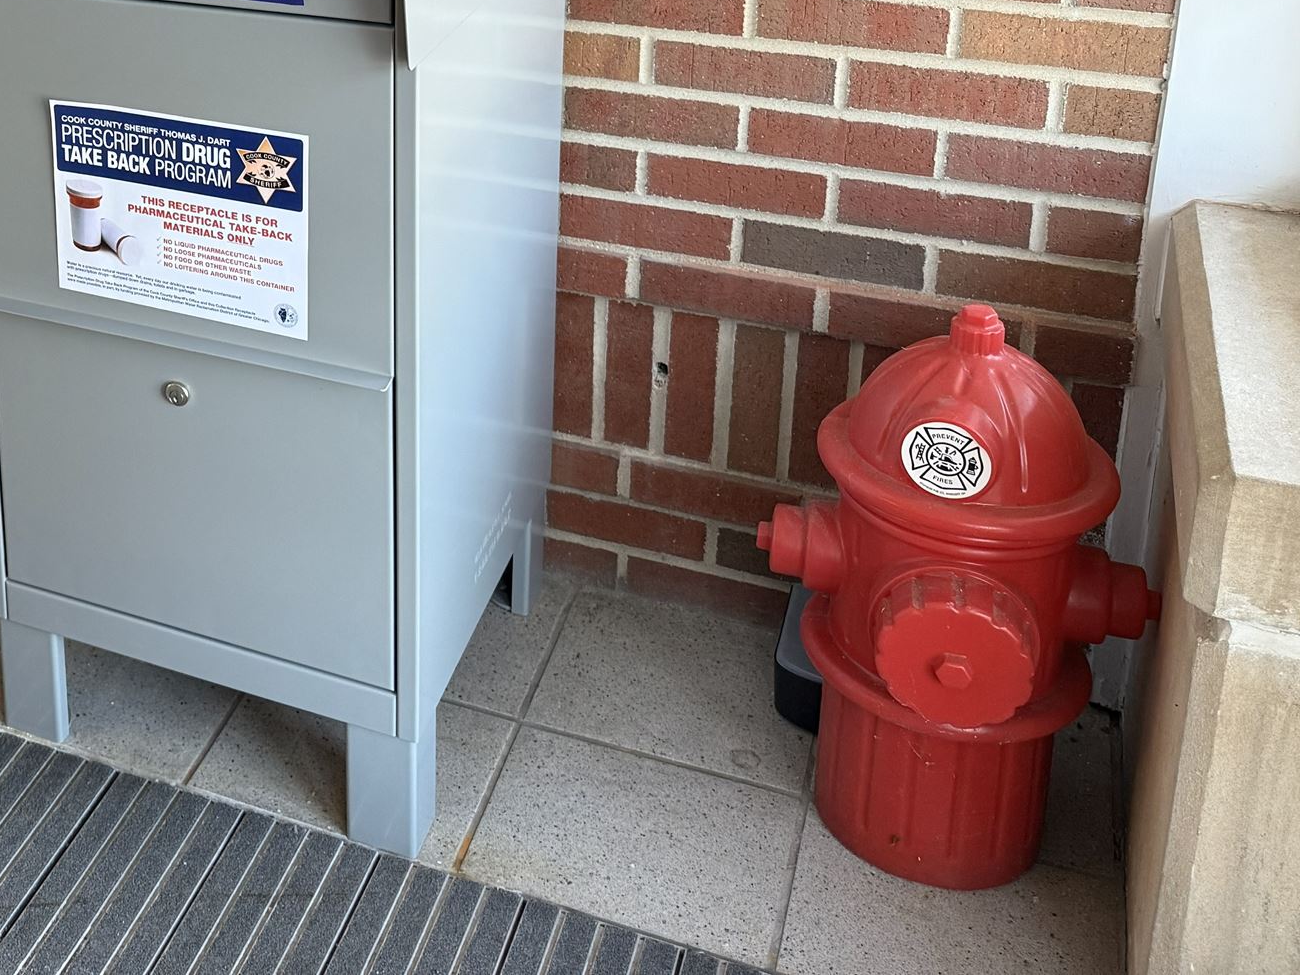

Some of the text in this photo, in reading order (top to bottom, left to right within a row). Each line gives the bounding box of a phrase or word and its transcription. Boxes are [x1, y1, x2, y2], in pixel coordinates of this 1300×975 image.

[60, 113, 230, 147] COOK COUNTY SHERIFF THOMAS J. DART
[61, 122, 230, 169] PRESCRIPTION DRUG
[61, 143, 231, 188] TAKE BACK PROGRAM
[263, 153, 287, 166] COUNTY
[249, 177, 281, 189] SHERIFF
[127, 203, 292, 242] PHARMACEUTICAL TAKE-BACK
[140, 195, 277, 227] THIS RECEPTACLE IS FOR
[163, 221, 254, 246] MATERIALS ONLY
[174, 240, 195, 249] LIQUID
[197, 244, 257, 261] PHARMACEUTICAL
[259, 256, 283, 266] DRUGS
[174, 247, 195, 257] LOOSE
[197, 252, 261, 270] PHARMACEUTICALS
[174, 255, 192, 264] FOOD
[204, 261, 227, 271] OTHER
[228, 266, 251, 276] WASTE
[174, 263, 208, 275] LOITERING
[210, 270, 237, 281] AROUND
[239, 276, 254, 284] THIS
[256, 279, 294, 292] CONTAINER
[931, 432, 966, 446] PREVENT
[932, 475, 954, 486] FIRES
